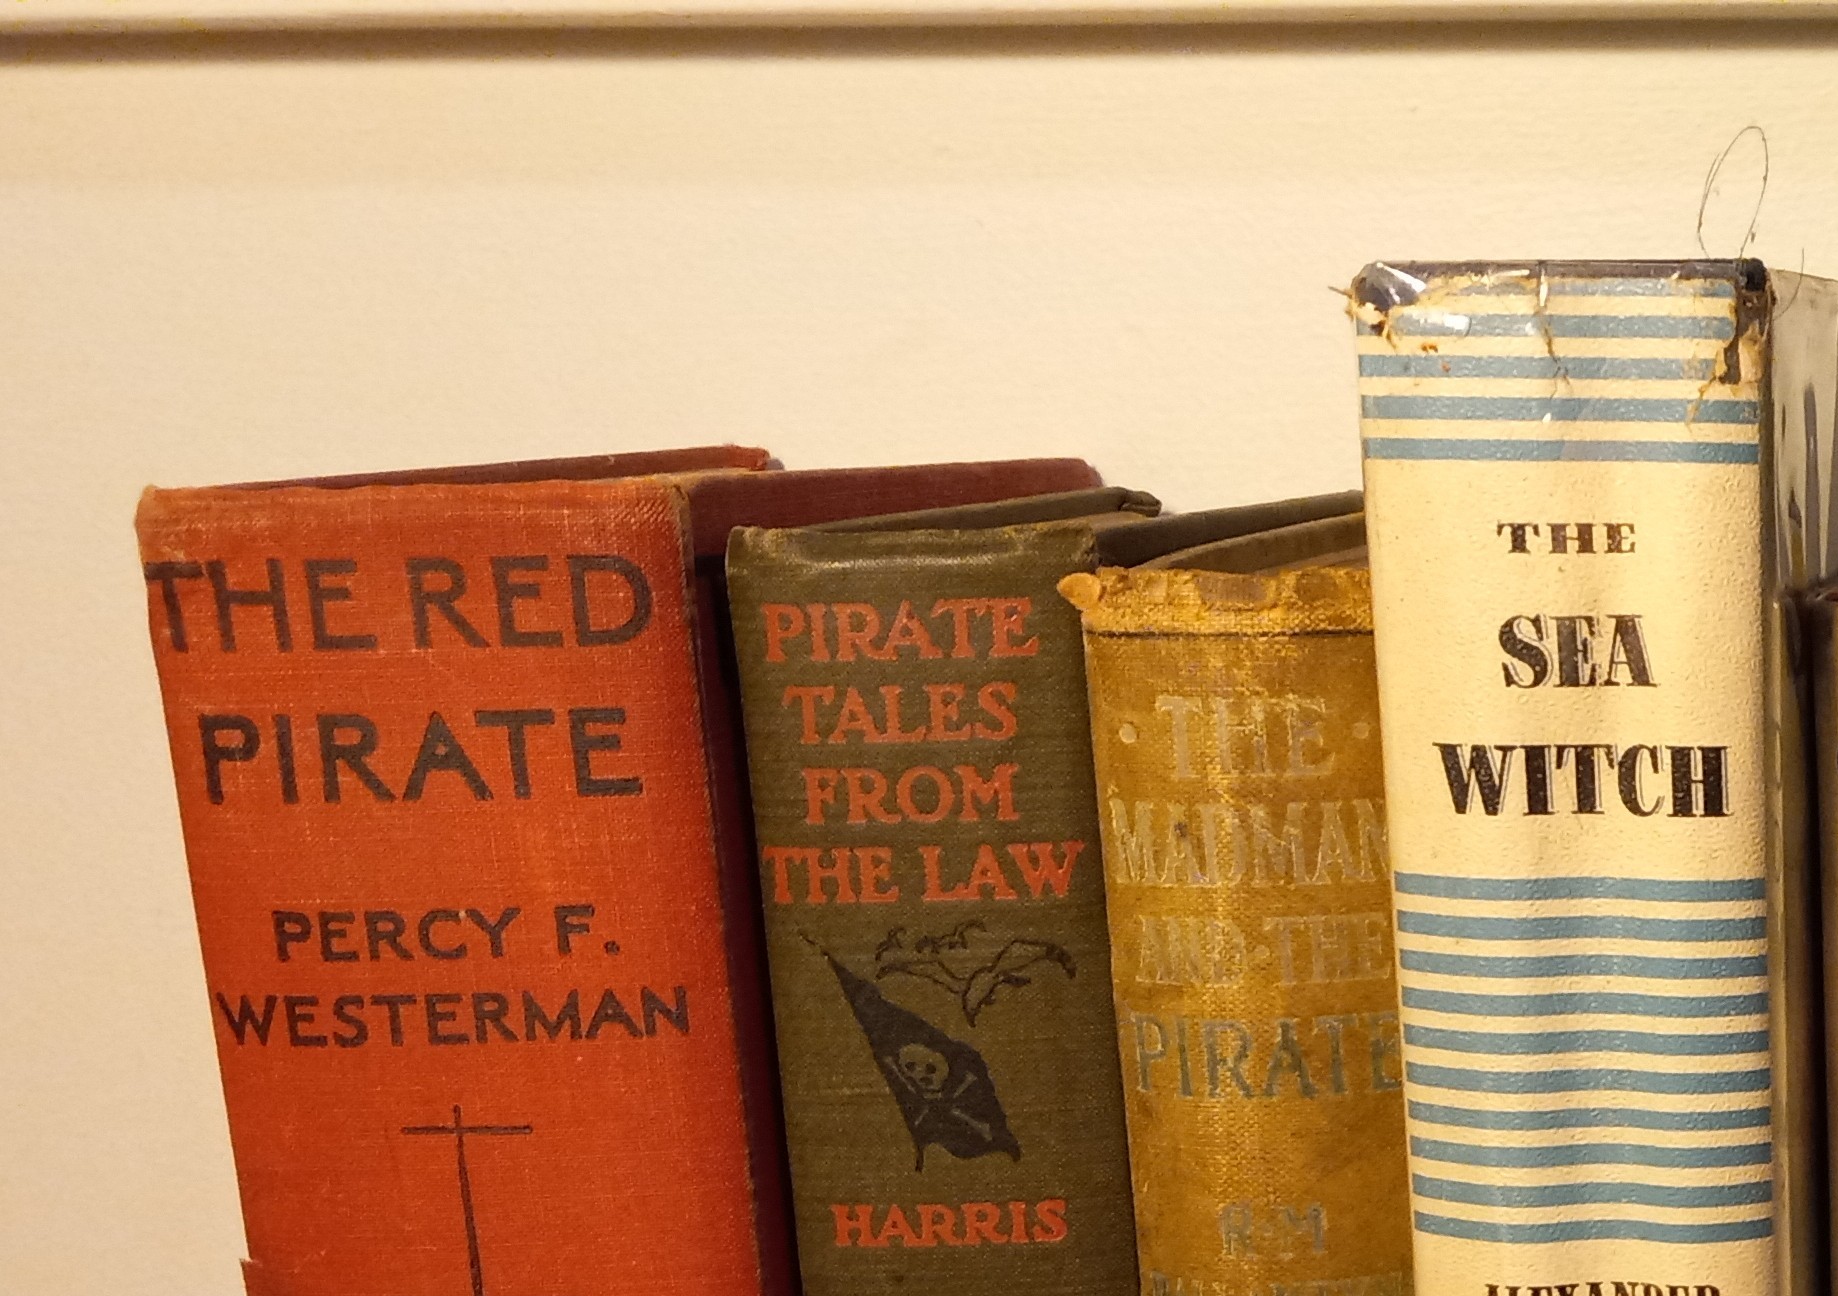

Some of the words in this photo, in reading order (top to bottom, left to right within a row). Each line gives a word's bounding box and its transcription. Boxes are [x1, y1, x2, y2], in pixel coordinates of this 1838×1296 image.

[1497, 522, 1637, 555] THE
[145, 558, 377, 652] THE
[406, 554, 656, 649] RED
[762, 597, 1038, 663] PIRATE
[1498, 613, 1660, 688] SEA
[783, 682, 1017, 745] TALES
[1156, 693, 1336, 781] THE
[197, 707, 643, 805] PIRATE
[1432, 742, 1732, 818] WITCH
[801, 765, 1019, 825] FROM
[763, 845, 897, 905] THE
[923, 840, 1084, 902] LAW
[272, 907, 521, 963] PERCY
[555, 904, 620, 956] F.
[216, 986, 691, 1047] WESTERMAN
[1134, 1010, 1402, 1099] PIRATE
[833, 1199, 1067, 1247] HARRIS
